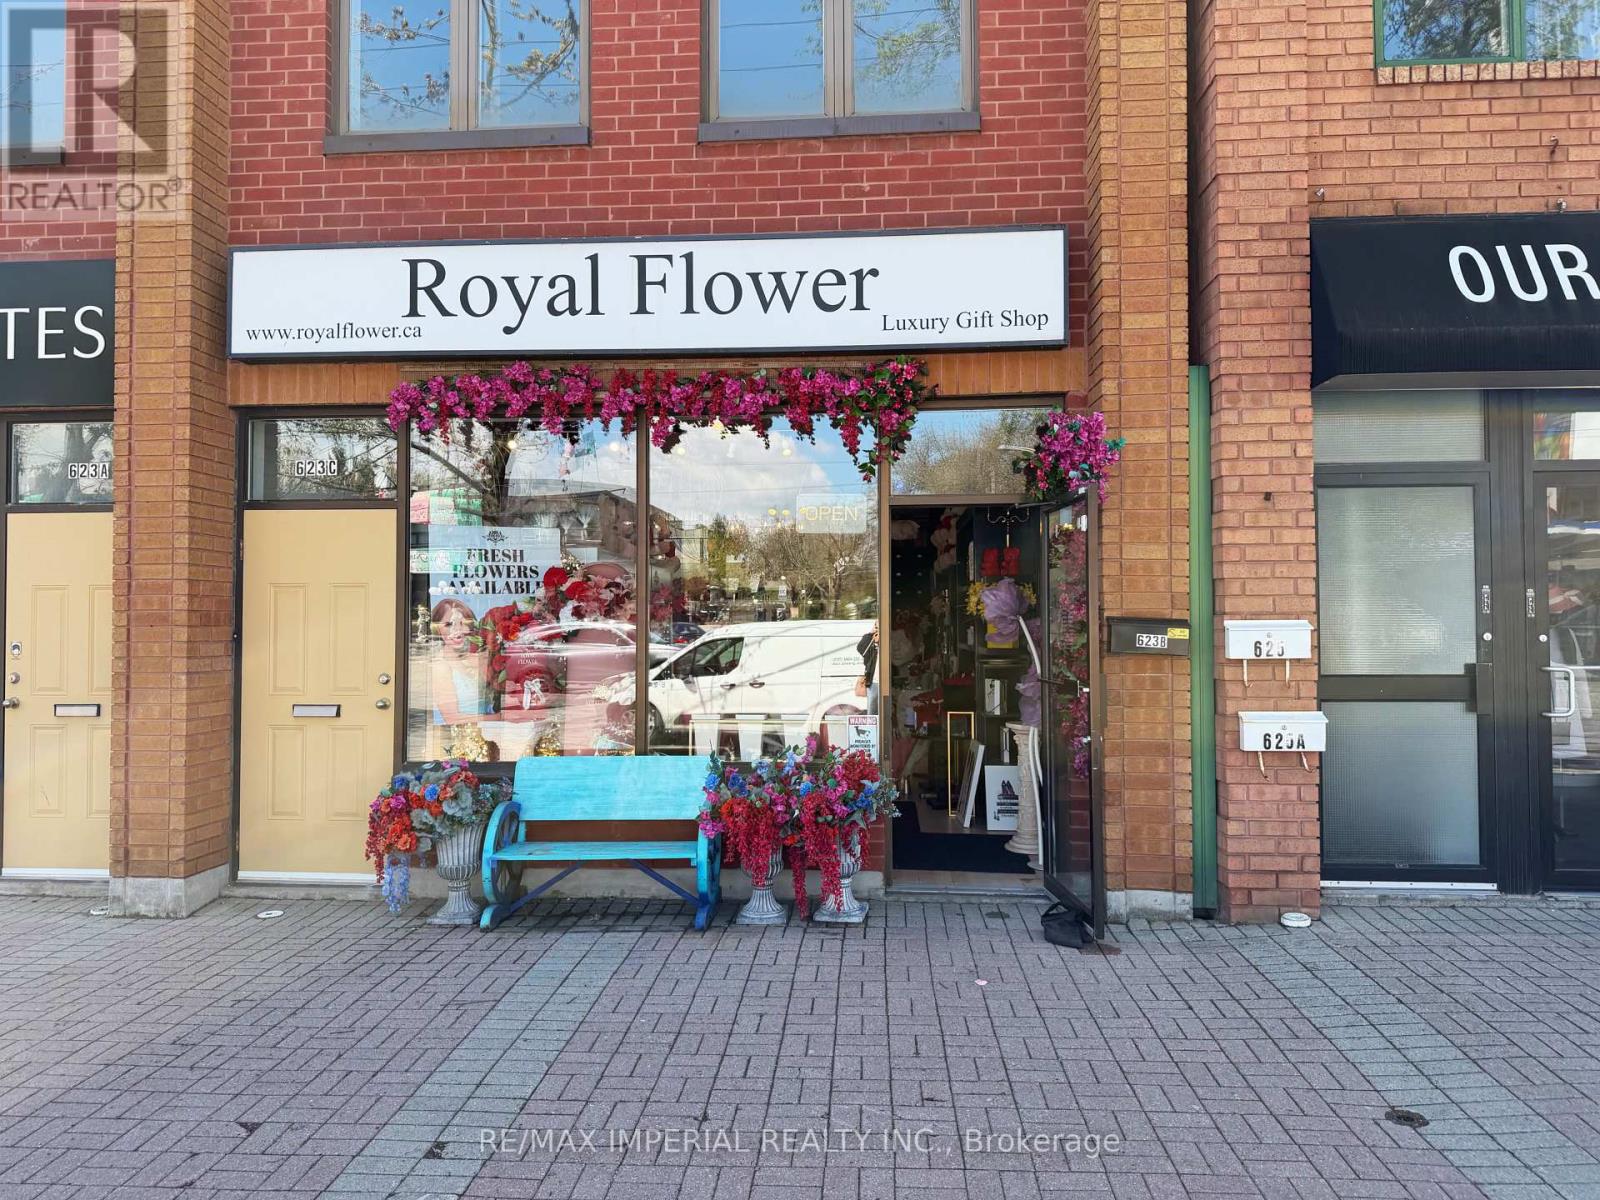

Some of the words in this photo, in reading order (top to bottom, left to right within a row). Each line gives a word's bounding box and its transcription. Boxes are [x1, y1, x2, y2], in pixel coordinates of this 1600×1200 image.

[1449, 243, 1600, 303] OUR
[401, 252, 605, 335] Royal
[629, 251, 880, 316] Flower
[882, 313, 950, 334] Luxury
[956, 310, 994, 330] Gift
[1000, 308, 1049, 329] Shop
[0, 305, 106, 360] TES
[246, 323, 422, 343] www.royalflower.ca
[70, 464, 107, 477] 623A
[296, 461, 335, 475] 623C
[806, 505, 857, 521] OPEN
[467, 548, 524, 563] FRESH
[453, 564, 539, 578] FLOWERS
[1137, 635, 1166, 648] 623B
